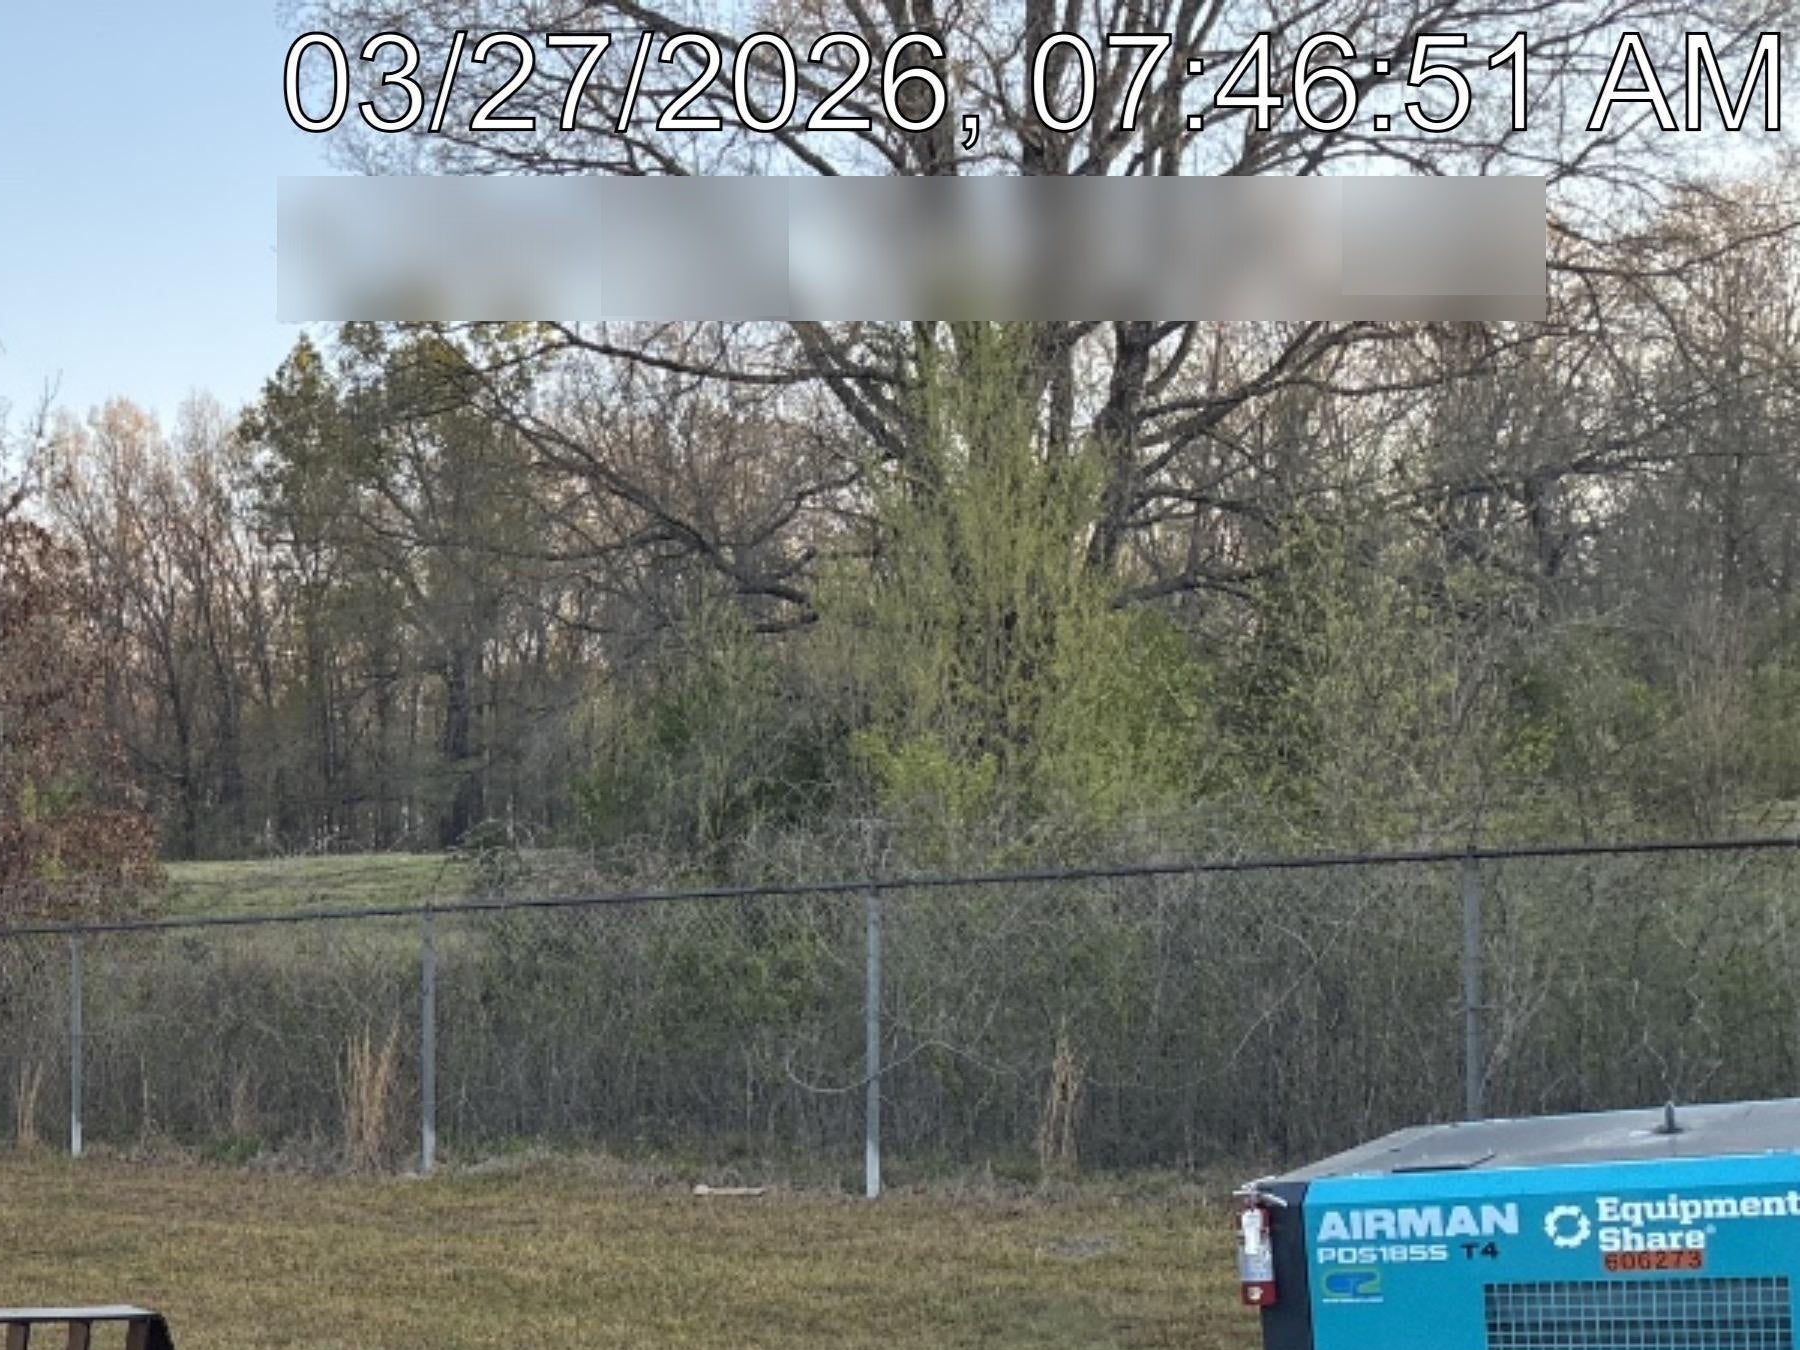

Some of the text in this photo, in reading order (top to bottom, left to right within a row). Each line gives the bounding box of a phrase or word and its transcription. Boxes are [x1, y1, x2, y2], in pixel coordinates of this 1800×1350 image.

[1596, 1190, 1800, 1227] Equipment
[1316, 1202, 1520, 1242] AIRMAN
[1460, 1241, 1499, 1260] T4
[1599, 1226, 1706, 1252] Share
[1604, 1250, 1703, 1272] 606273
